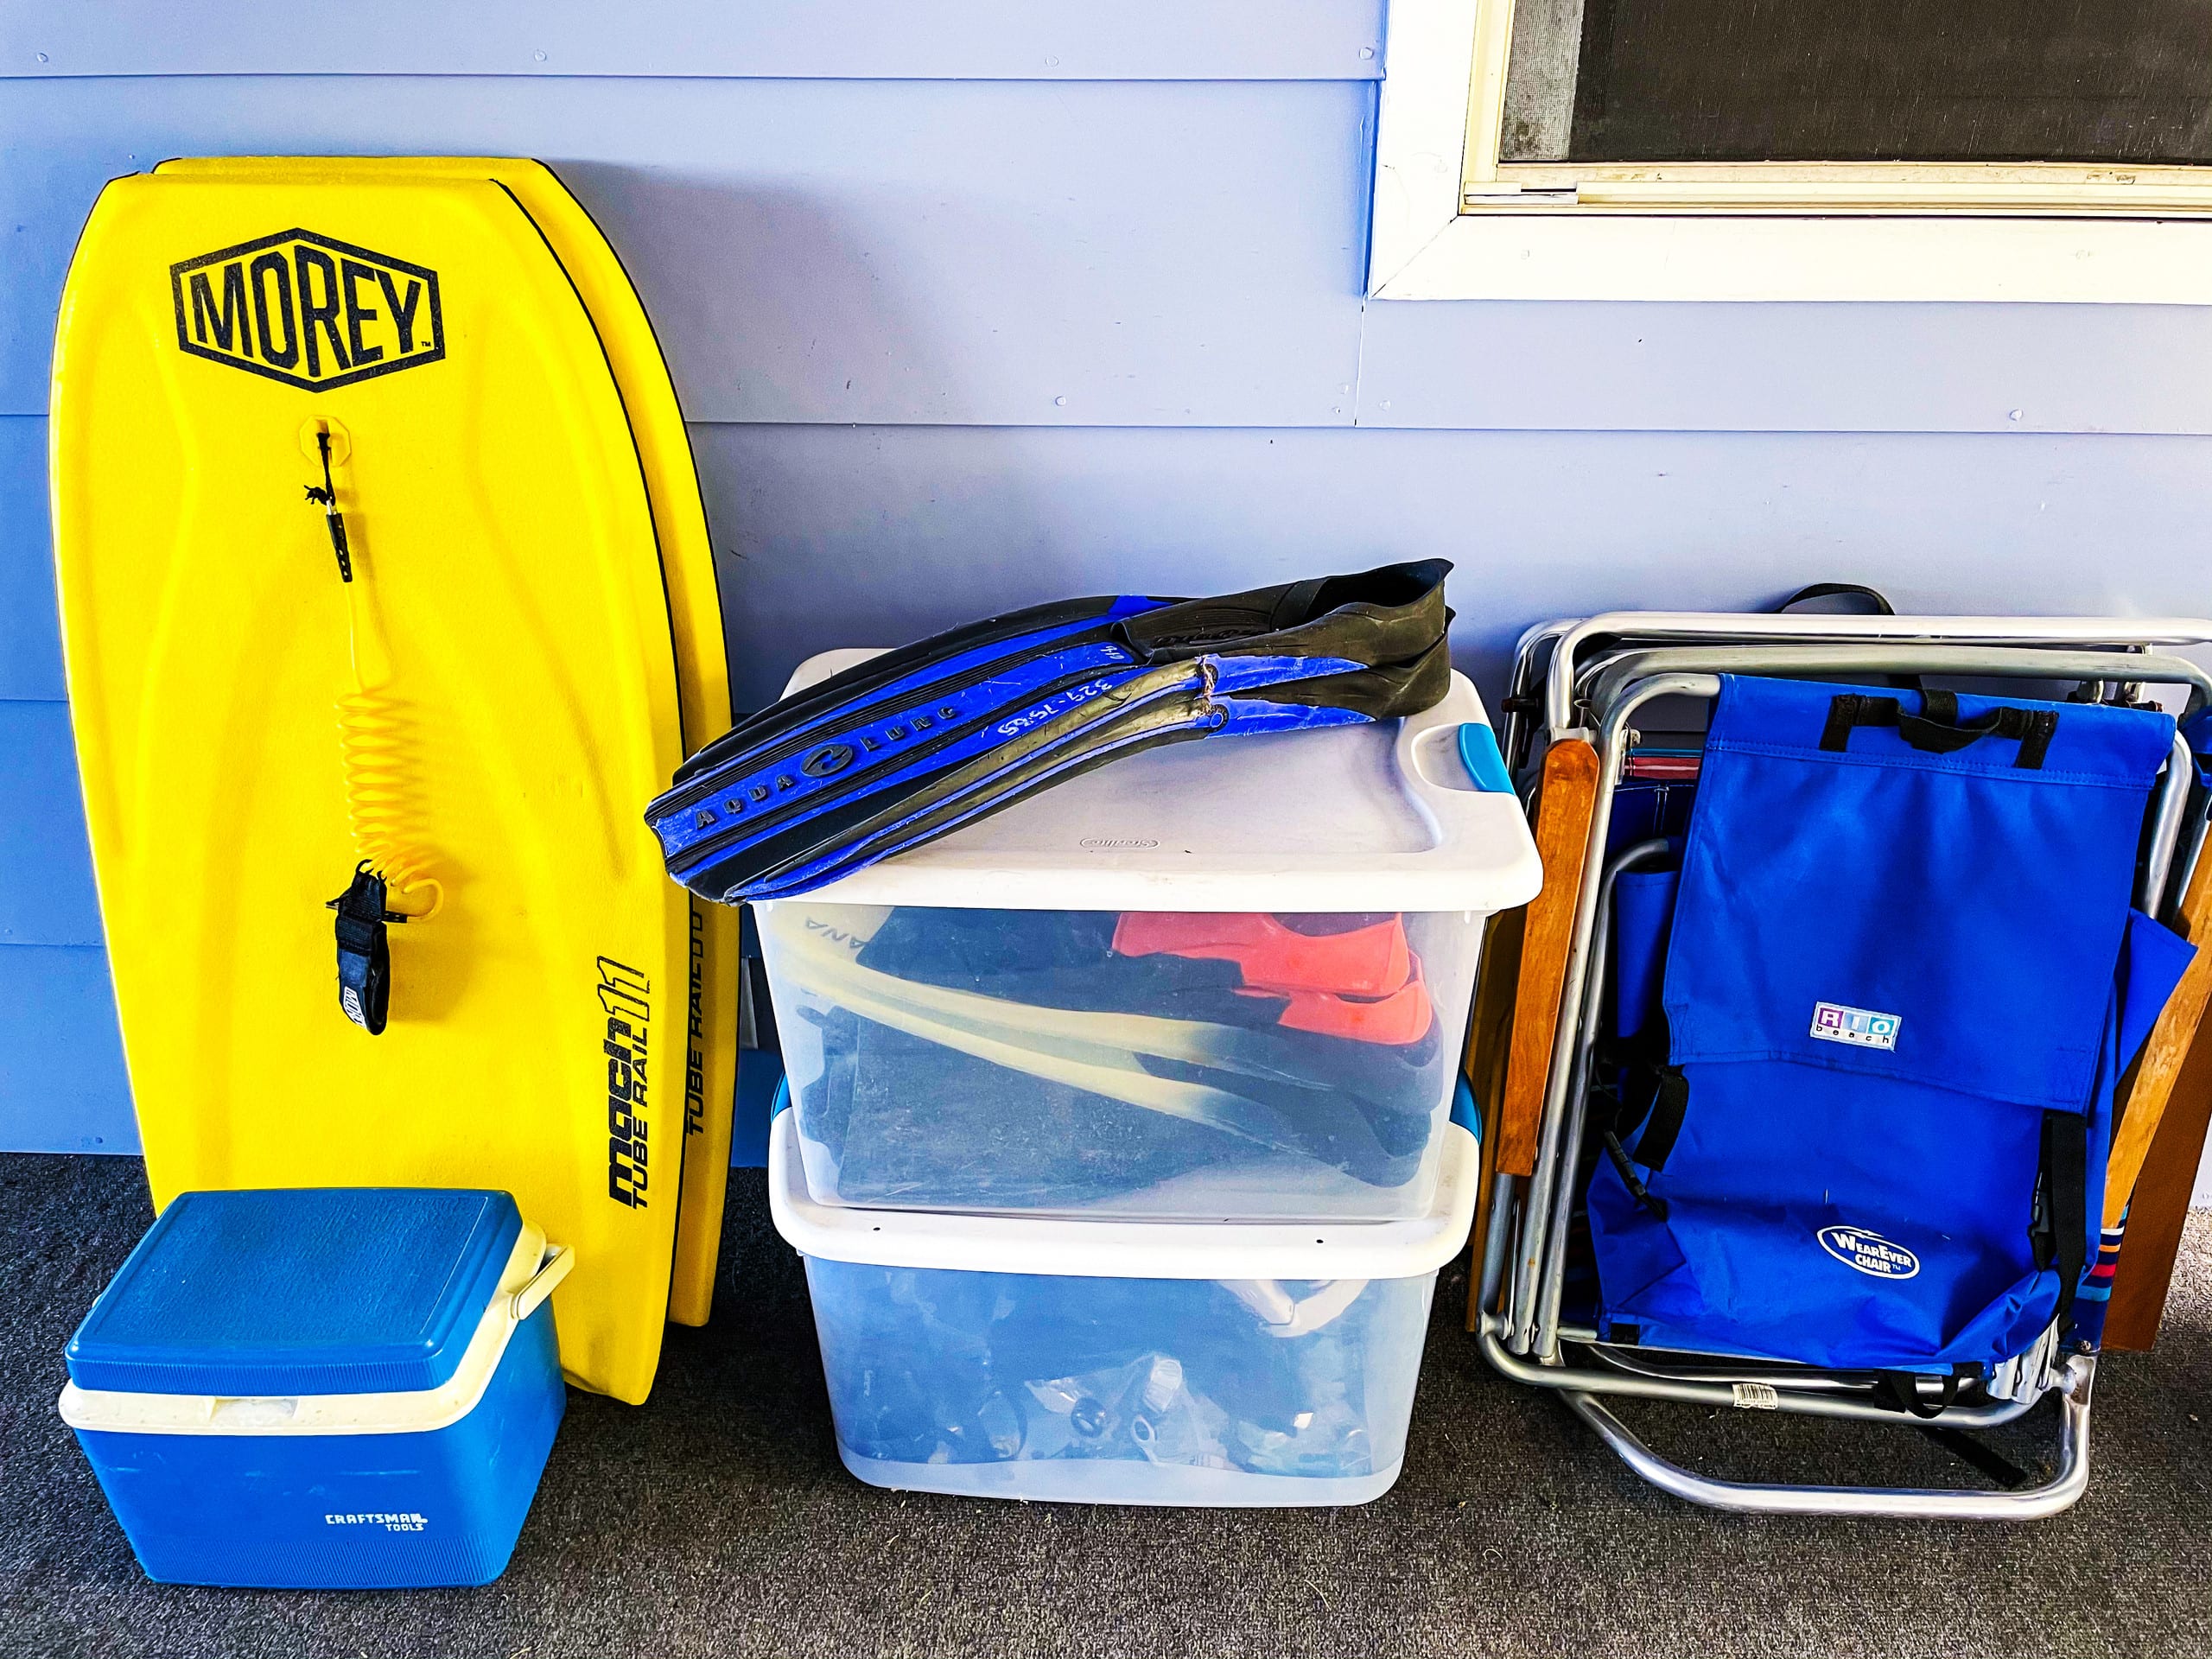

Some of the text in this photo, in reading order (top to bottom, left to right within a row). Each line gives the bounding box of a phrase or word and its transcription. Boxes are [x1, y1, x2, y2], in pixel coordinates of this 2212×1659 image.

[188, 244, 422, 378] MOREY
[694, 704, 959, 831] AQUA LUNG
[1815, 1025, 1890, 1044] beach
[1819, 1008, 1892, 1034] RIO
[632, 1027, 649, 1210] TUBE RAIL
[688, 1048, 704, 1135] TUBE
[1854, 1254, 1891, 1273] CHAIR
[385, 1523, 424, 1532] TOOLS
